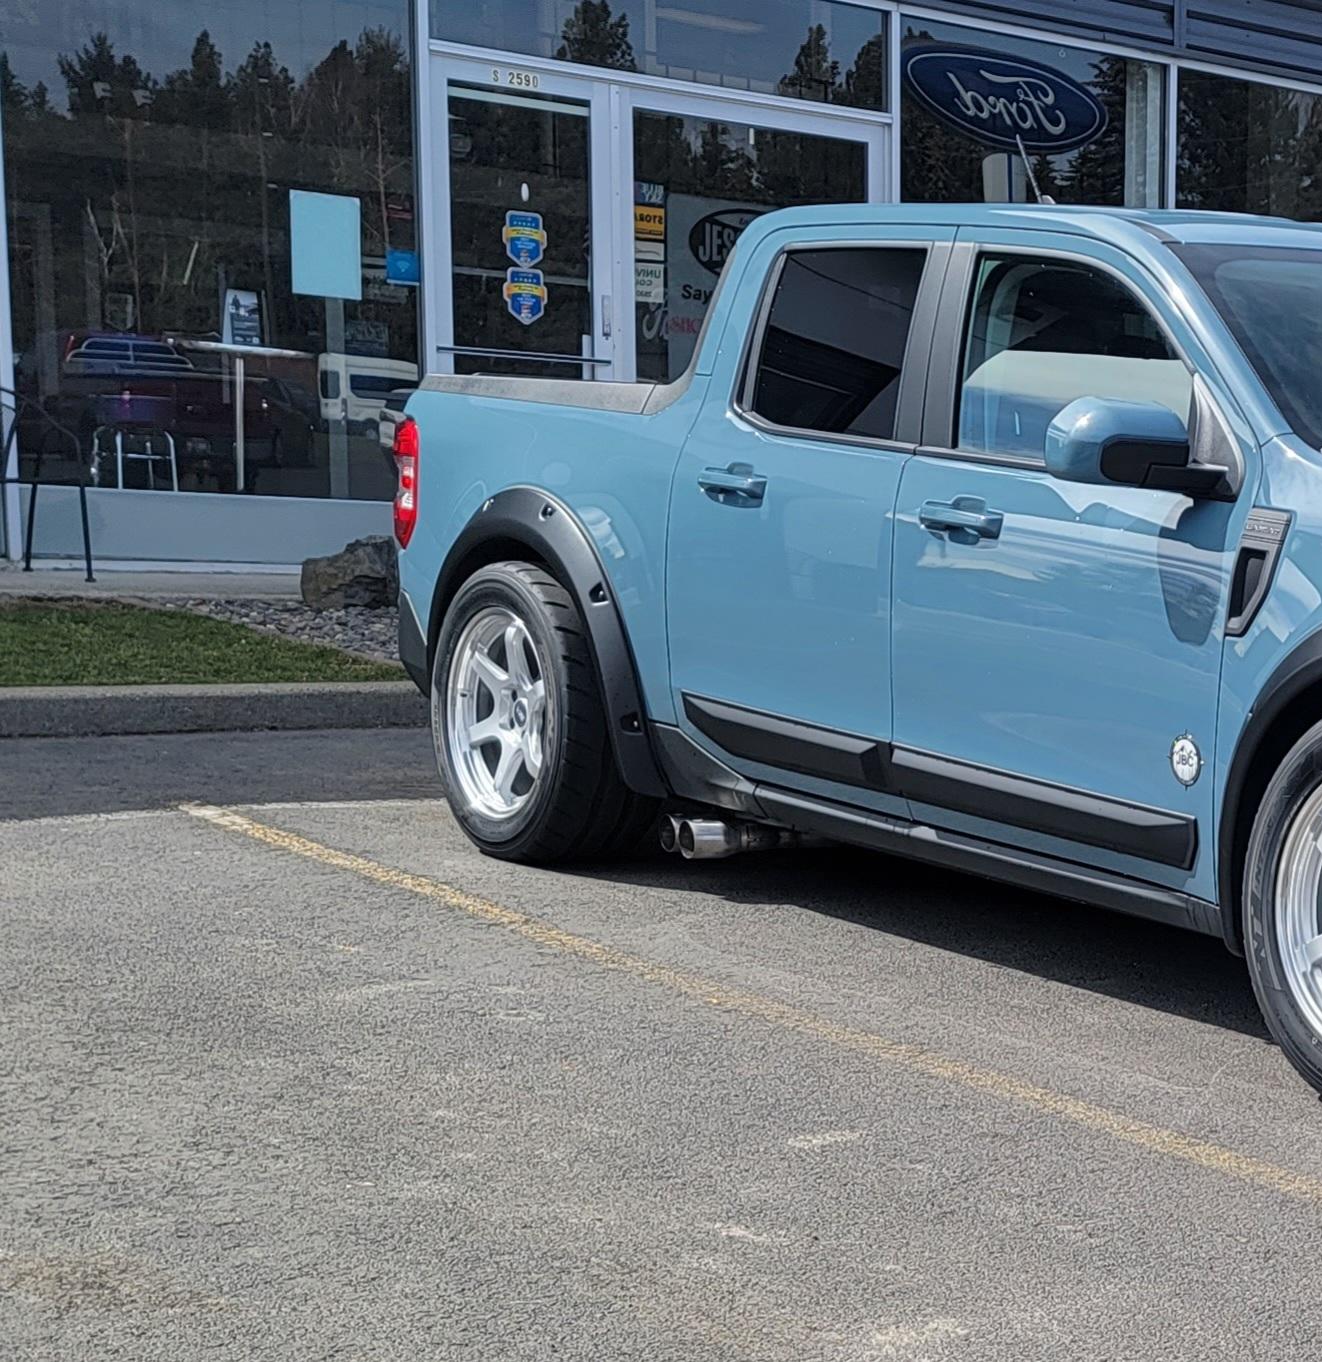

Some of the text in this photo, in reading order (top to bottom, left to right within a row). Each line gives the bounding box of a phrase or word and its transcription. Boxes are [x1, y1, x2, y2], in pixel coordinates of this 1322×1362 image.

[492, 70, 539, 88] S 2590
[698, 221, 738, 262] JES
